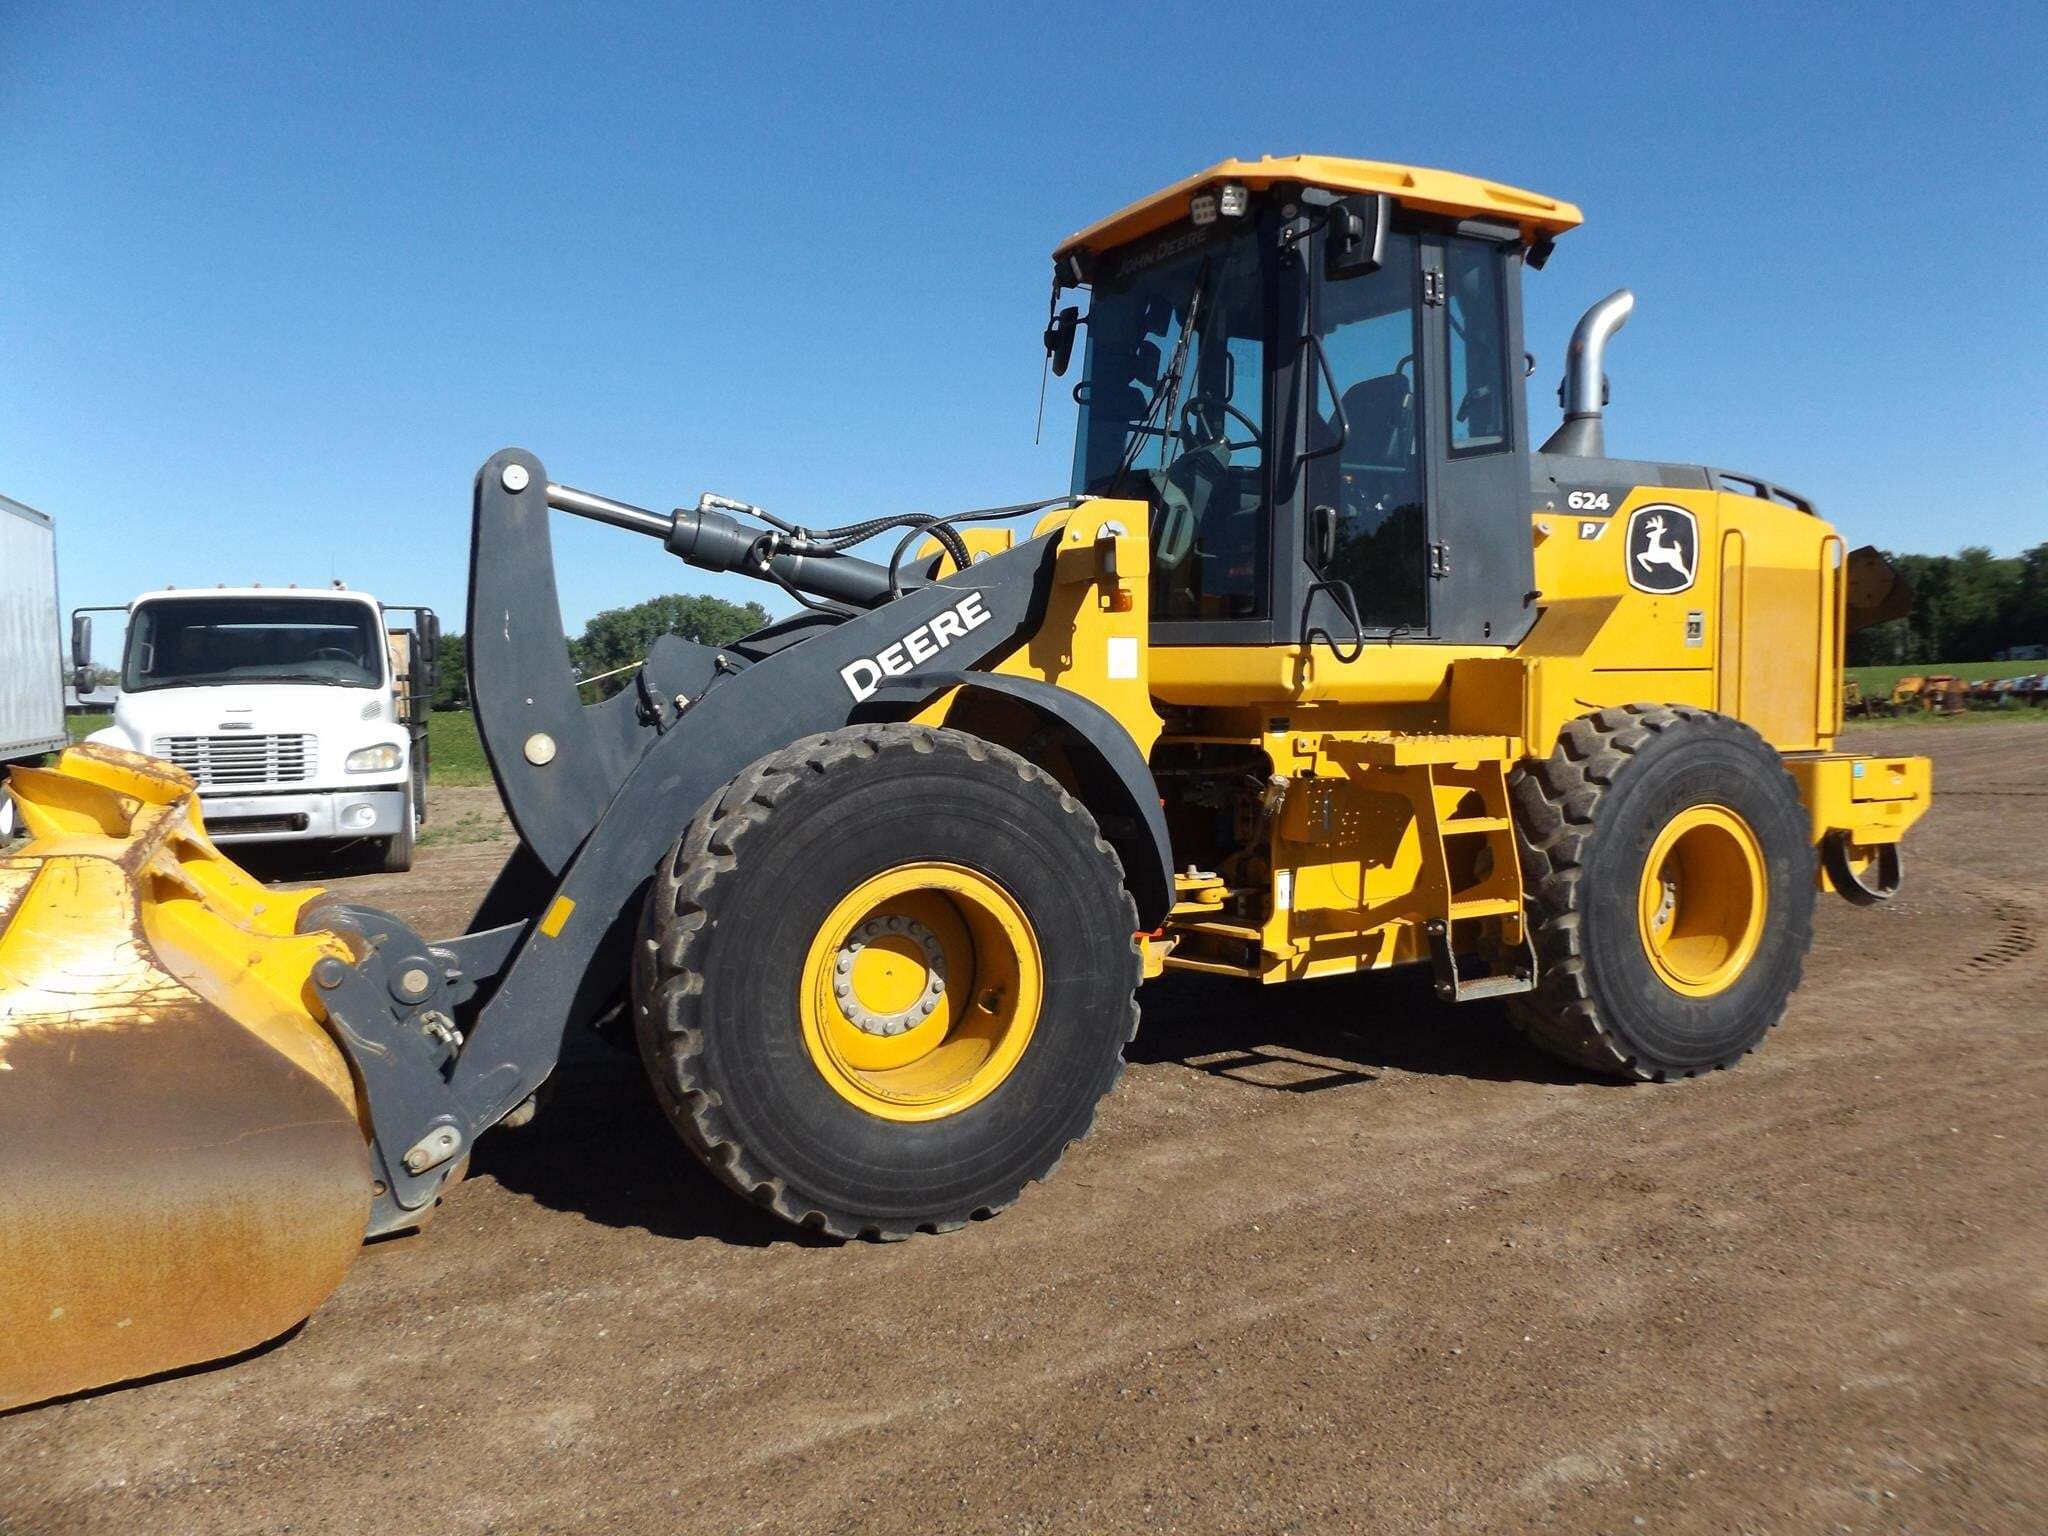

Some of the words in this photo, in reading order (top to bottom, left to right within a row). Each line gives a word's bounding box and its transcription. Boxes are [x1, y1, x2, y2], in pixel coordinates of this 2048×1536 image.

[1156, 226, 1208, 261] DEERE
[1567, 490, 1611, 511] 624
[839, 591, 993, 703] DEERE
